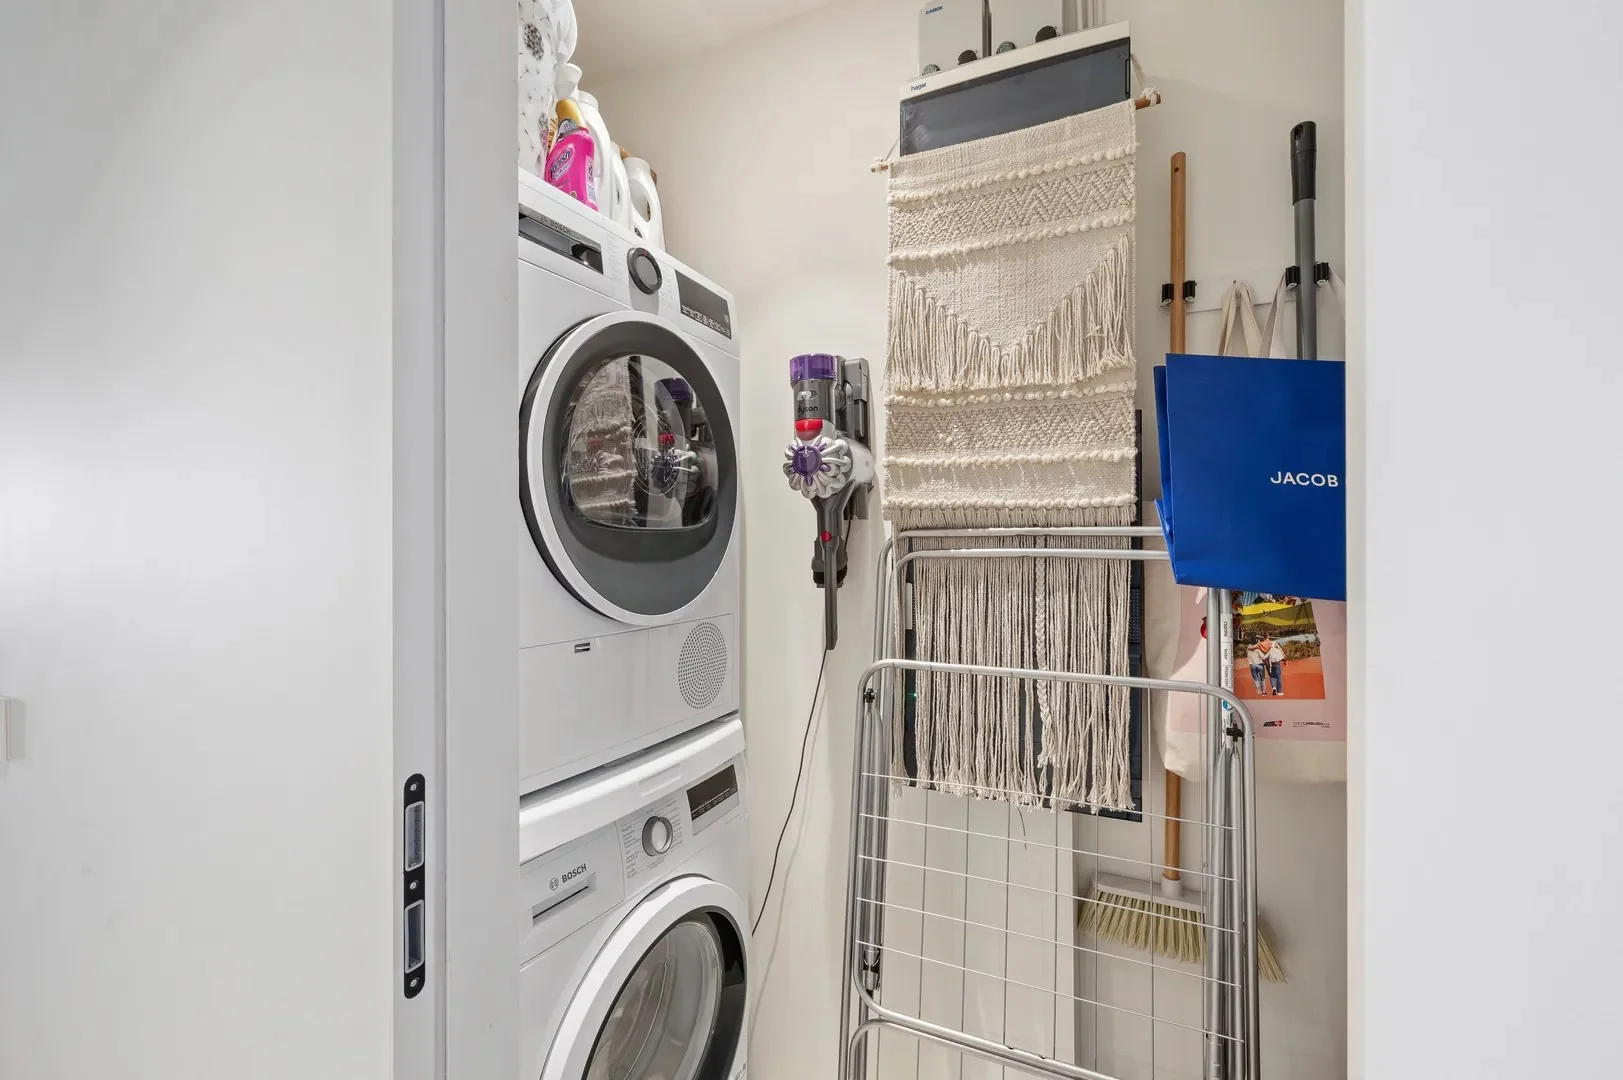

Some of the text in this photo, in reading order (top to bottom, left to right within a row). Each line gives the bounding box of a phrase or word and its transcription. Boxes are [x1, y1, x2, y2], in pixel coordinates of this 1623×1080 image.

[911, 82, 926, 92] hager
[797, 404, 819, 415] dyson
[1270, 471, 1339, 488] JACOB
[561, 863, 587, 884] BOSCH
